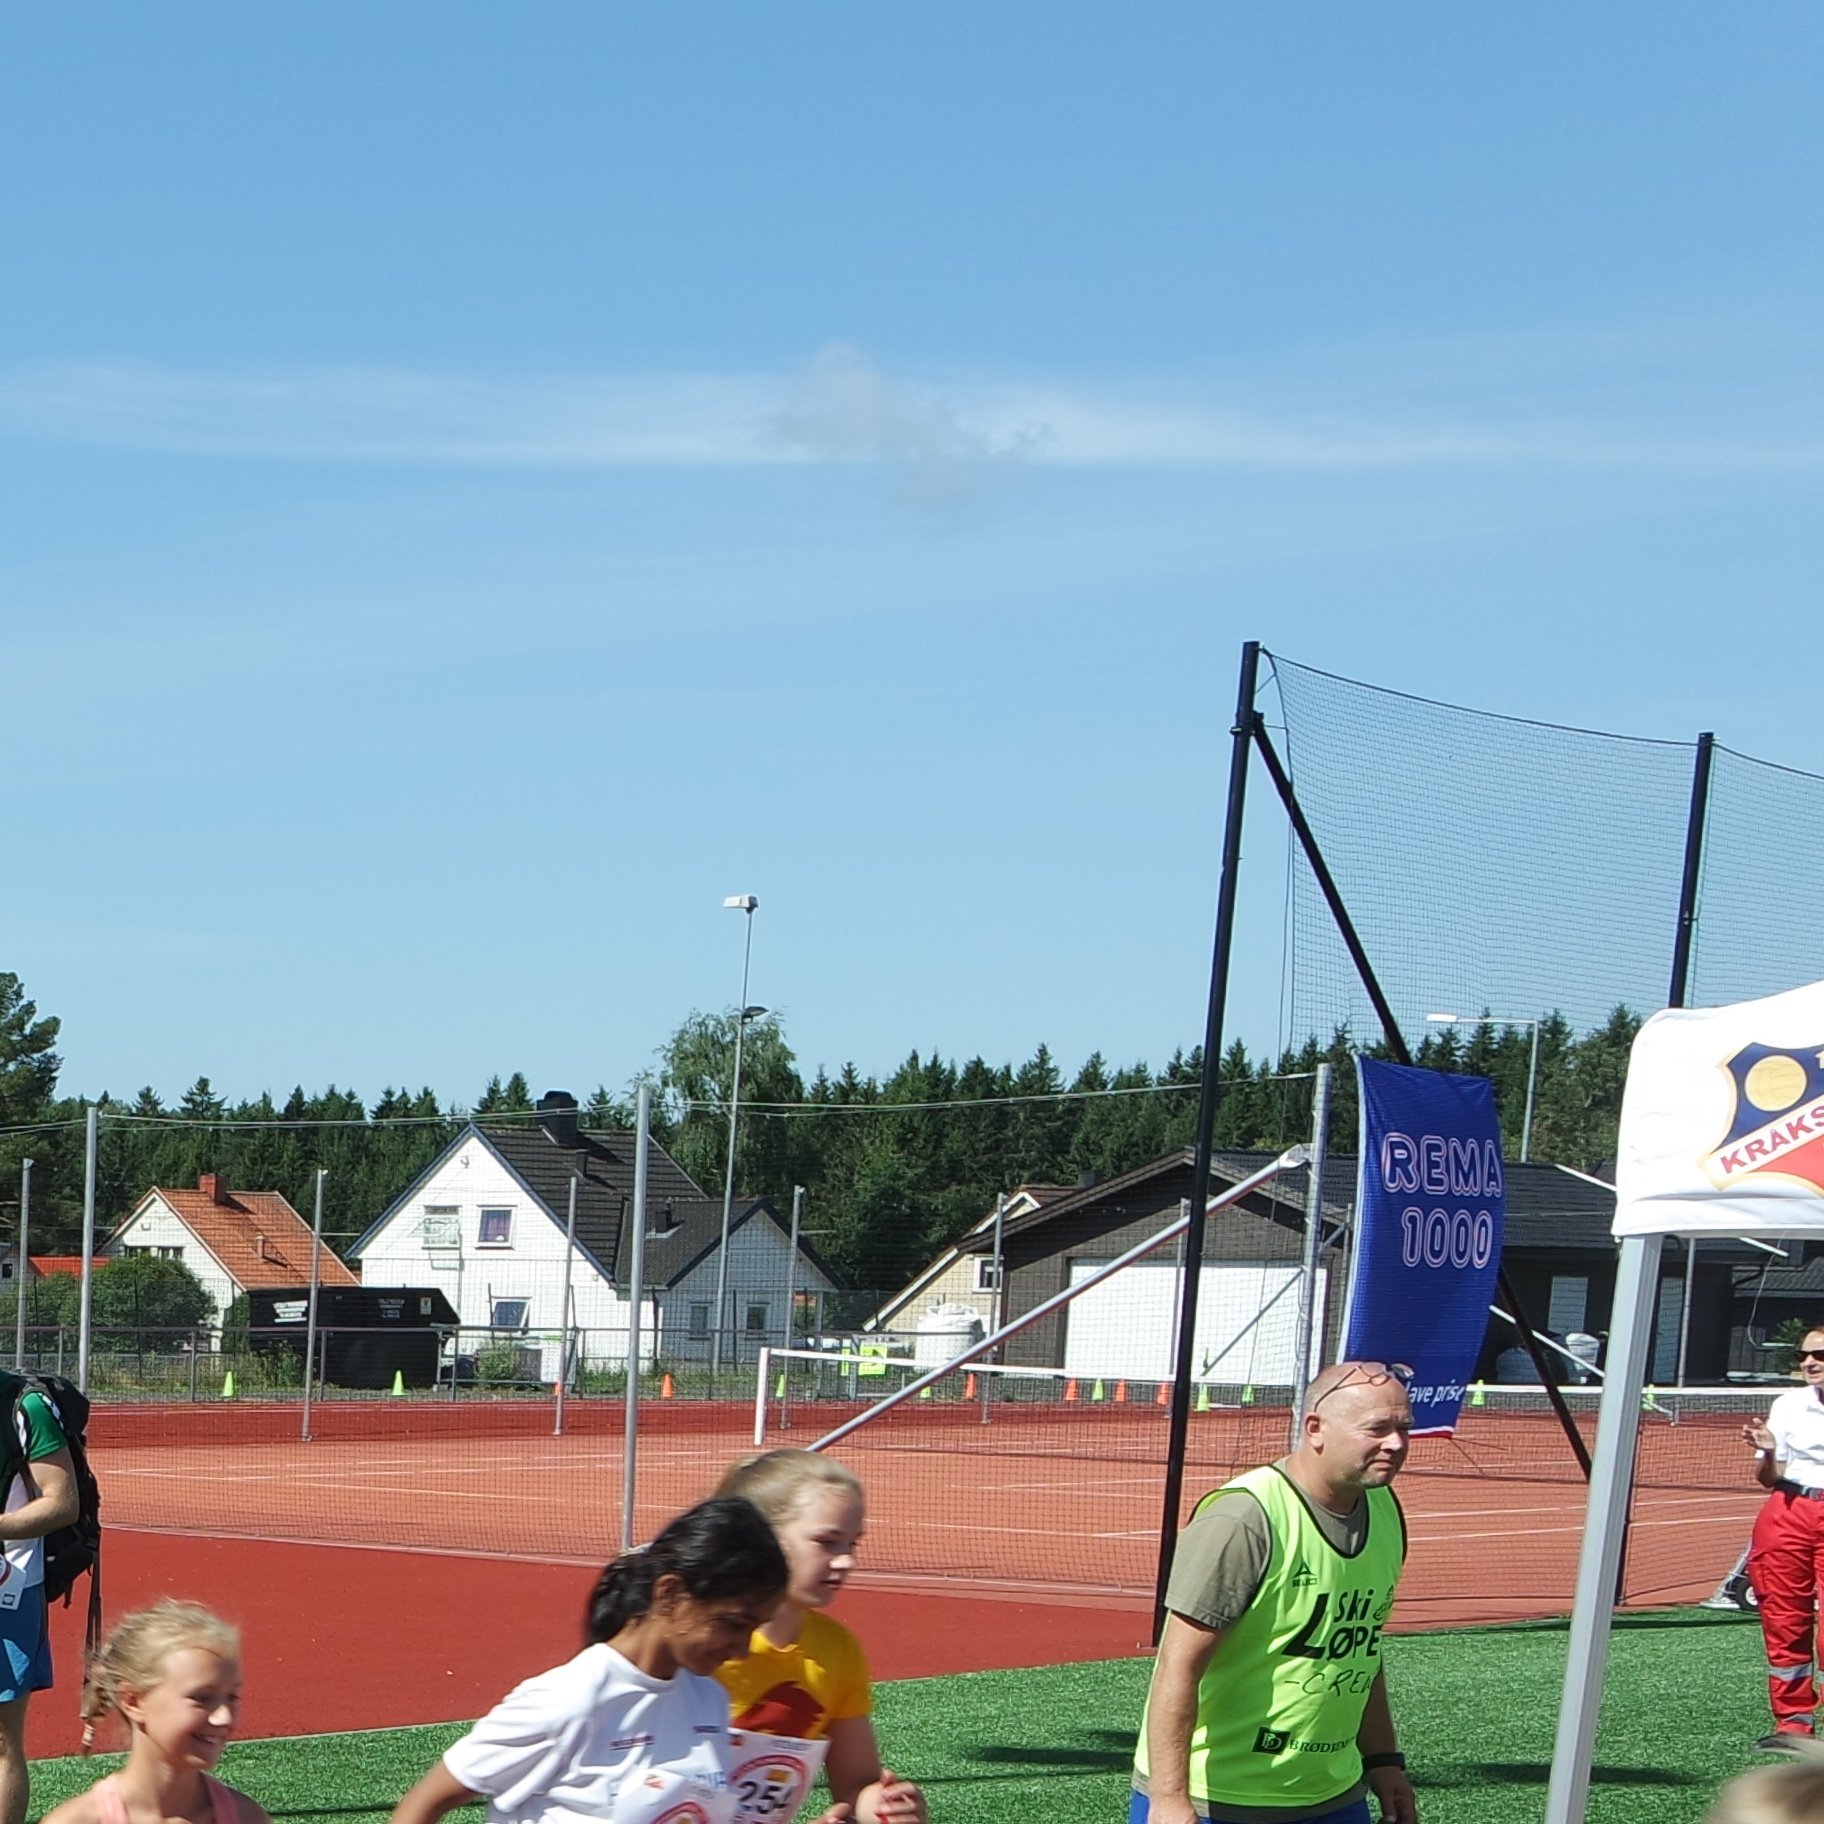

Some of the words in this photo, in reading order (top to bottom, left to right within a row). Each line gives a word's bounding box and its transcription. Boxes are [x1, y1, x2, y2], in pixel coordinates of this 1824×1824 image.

[1381, 1132, 1502, 1198] REMA
[1402, 1206, 1494, 1270] 1000
[1334, 1588, 1374, 1623] Ski
